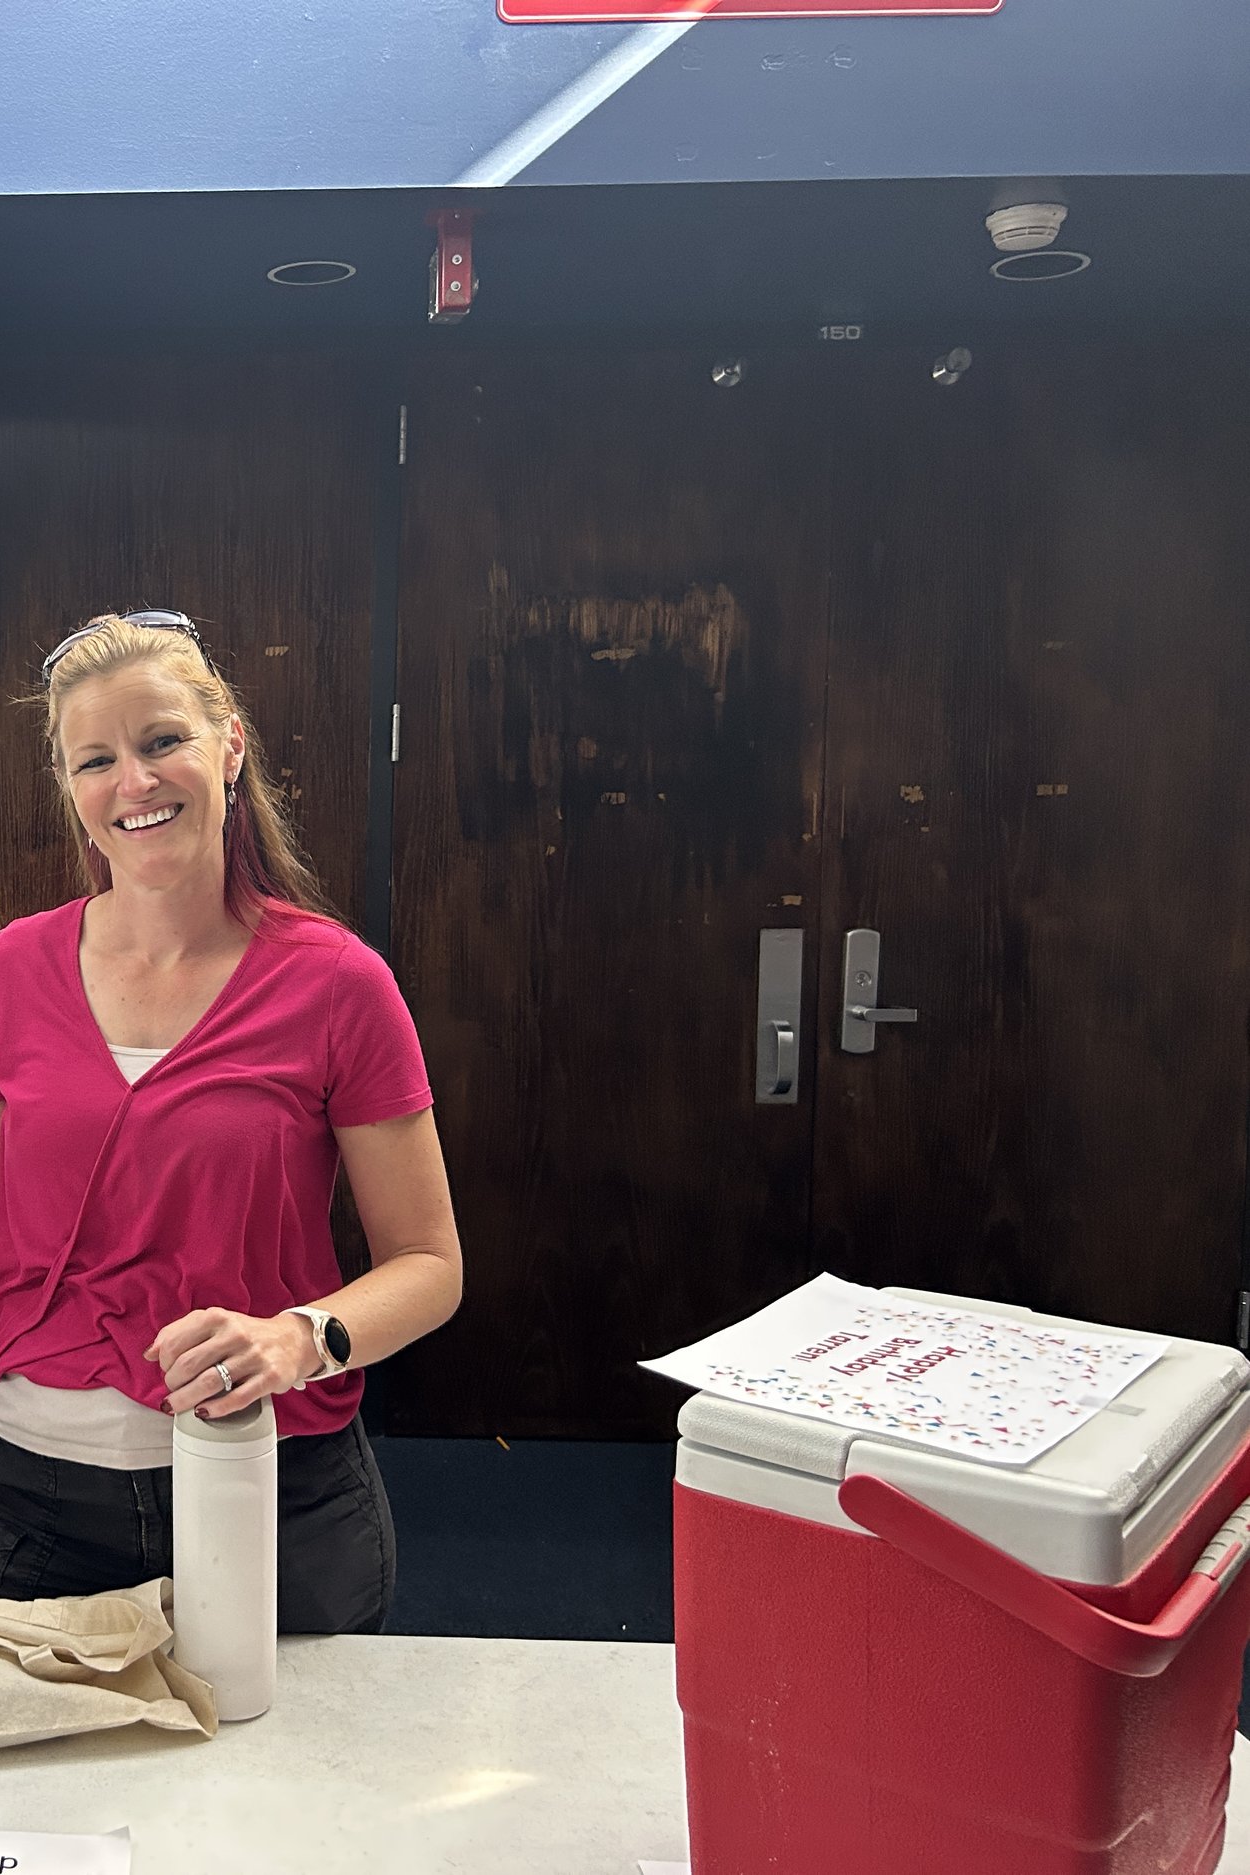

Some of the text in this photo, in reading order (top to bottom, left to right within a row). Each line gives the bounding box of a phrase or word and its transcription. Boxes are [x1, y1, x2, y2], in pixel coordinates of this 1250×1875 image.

[820, 326, 860, 339] 150
[791, 1331, 869, 1362] Tarren!
[829, 1337, 923, 1376] Birthday
[887, 1346, 967, 1381] Happy
